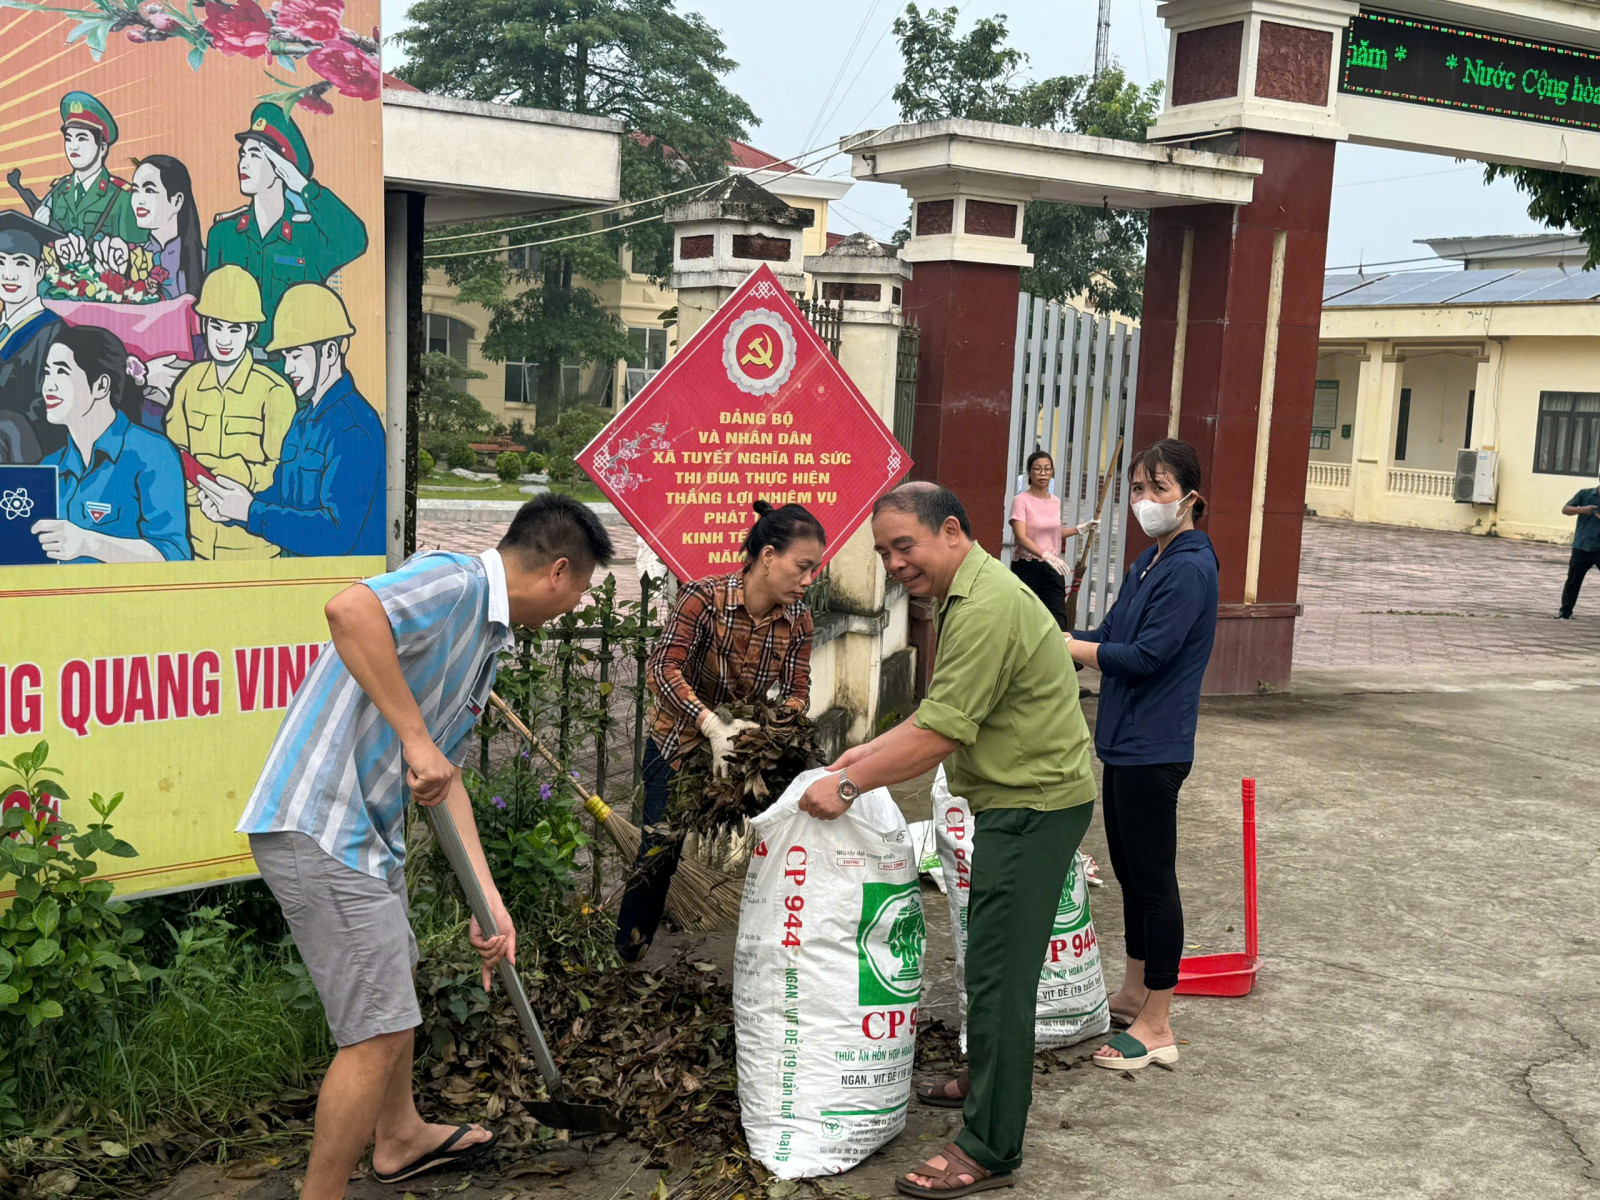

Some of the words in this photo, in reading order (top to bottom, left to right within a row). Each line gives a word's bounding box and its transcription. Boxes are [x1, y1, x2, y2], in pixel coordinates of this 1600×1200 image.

[1462, 57, 1516, 91] Nước
[1522, 68, 1569, 106] Cộng
[719, 408, 767, 425] ĐẢNG
[771, 411, 794, 428] BỘ
[698, 429, 721, 444] VÀ
[725, 430, 773, 445] NHÂN
[778, 431, 812, 446] DÂN
[652, 449, 677, 464] XÃ
[681, 448, 733, 465] TUYẾT
[737, 450, 789, 465] NGHĨA
[793, 452, 815, 465] RA
[819, 451, 852, 465] SỨC
[675, 472, 701, 484] THI
[706, 472, 740, 484] ĐUA
[745, 471, 788, 487] THỰC
[792, 470, 830, 487] HIỆN
[665, 488, 722, 505] THẮNG
[727, 491, 753, 507] LỢI
[817, 491, 837, 506] VỤ
[704, 510, 748, 524] PHÁT
[682, 531, 724, 545] KINH
[729, 528, 749, 544] TẾ
[59, 649, 221, 738] QUANG
[945, 807, 965, 841] CP
[785, 845, 807, 887] CP
[954, 847, 971, 890] 944
[781, 895, 805, 948] 944
[1072, 927, 1096, 958] 944
[1042, 989, 1055, 1000] VỊT
[1071, 984, 1082, 996] (19
[783, 1008, 799, 1026] VỊT
[862, 1010, 906, 1040] CP
[781, 1049, 798, 1069] (19
[834, 1048, 856, 1062] THỨC
[859, 1048, 870, 1061] ĂN
[872, 1045, 887, 1061] HỖN
[888, 1047, 901, 1062] HỢP
[782, 1071, 800, 1096] tuần
[841, 1074, 870, 1086] NGAN,
[873, 1073, 886, 1086] VỊT
[887, 1066, 898, 1082] ĐẺ
